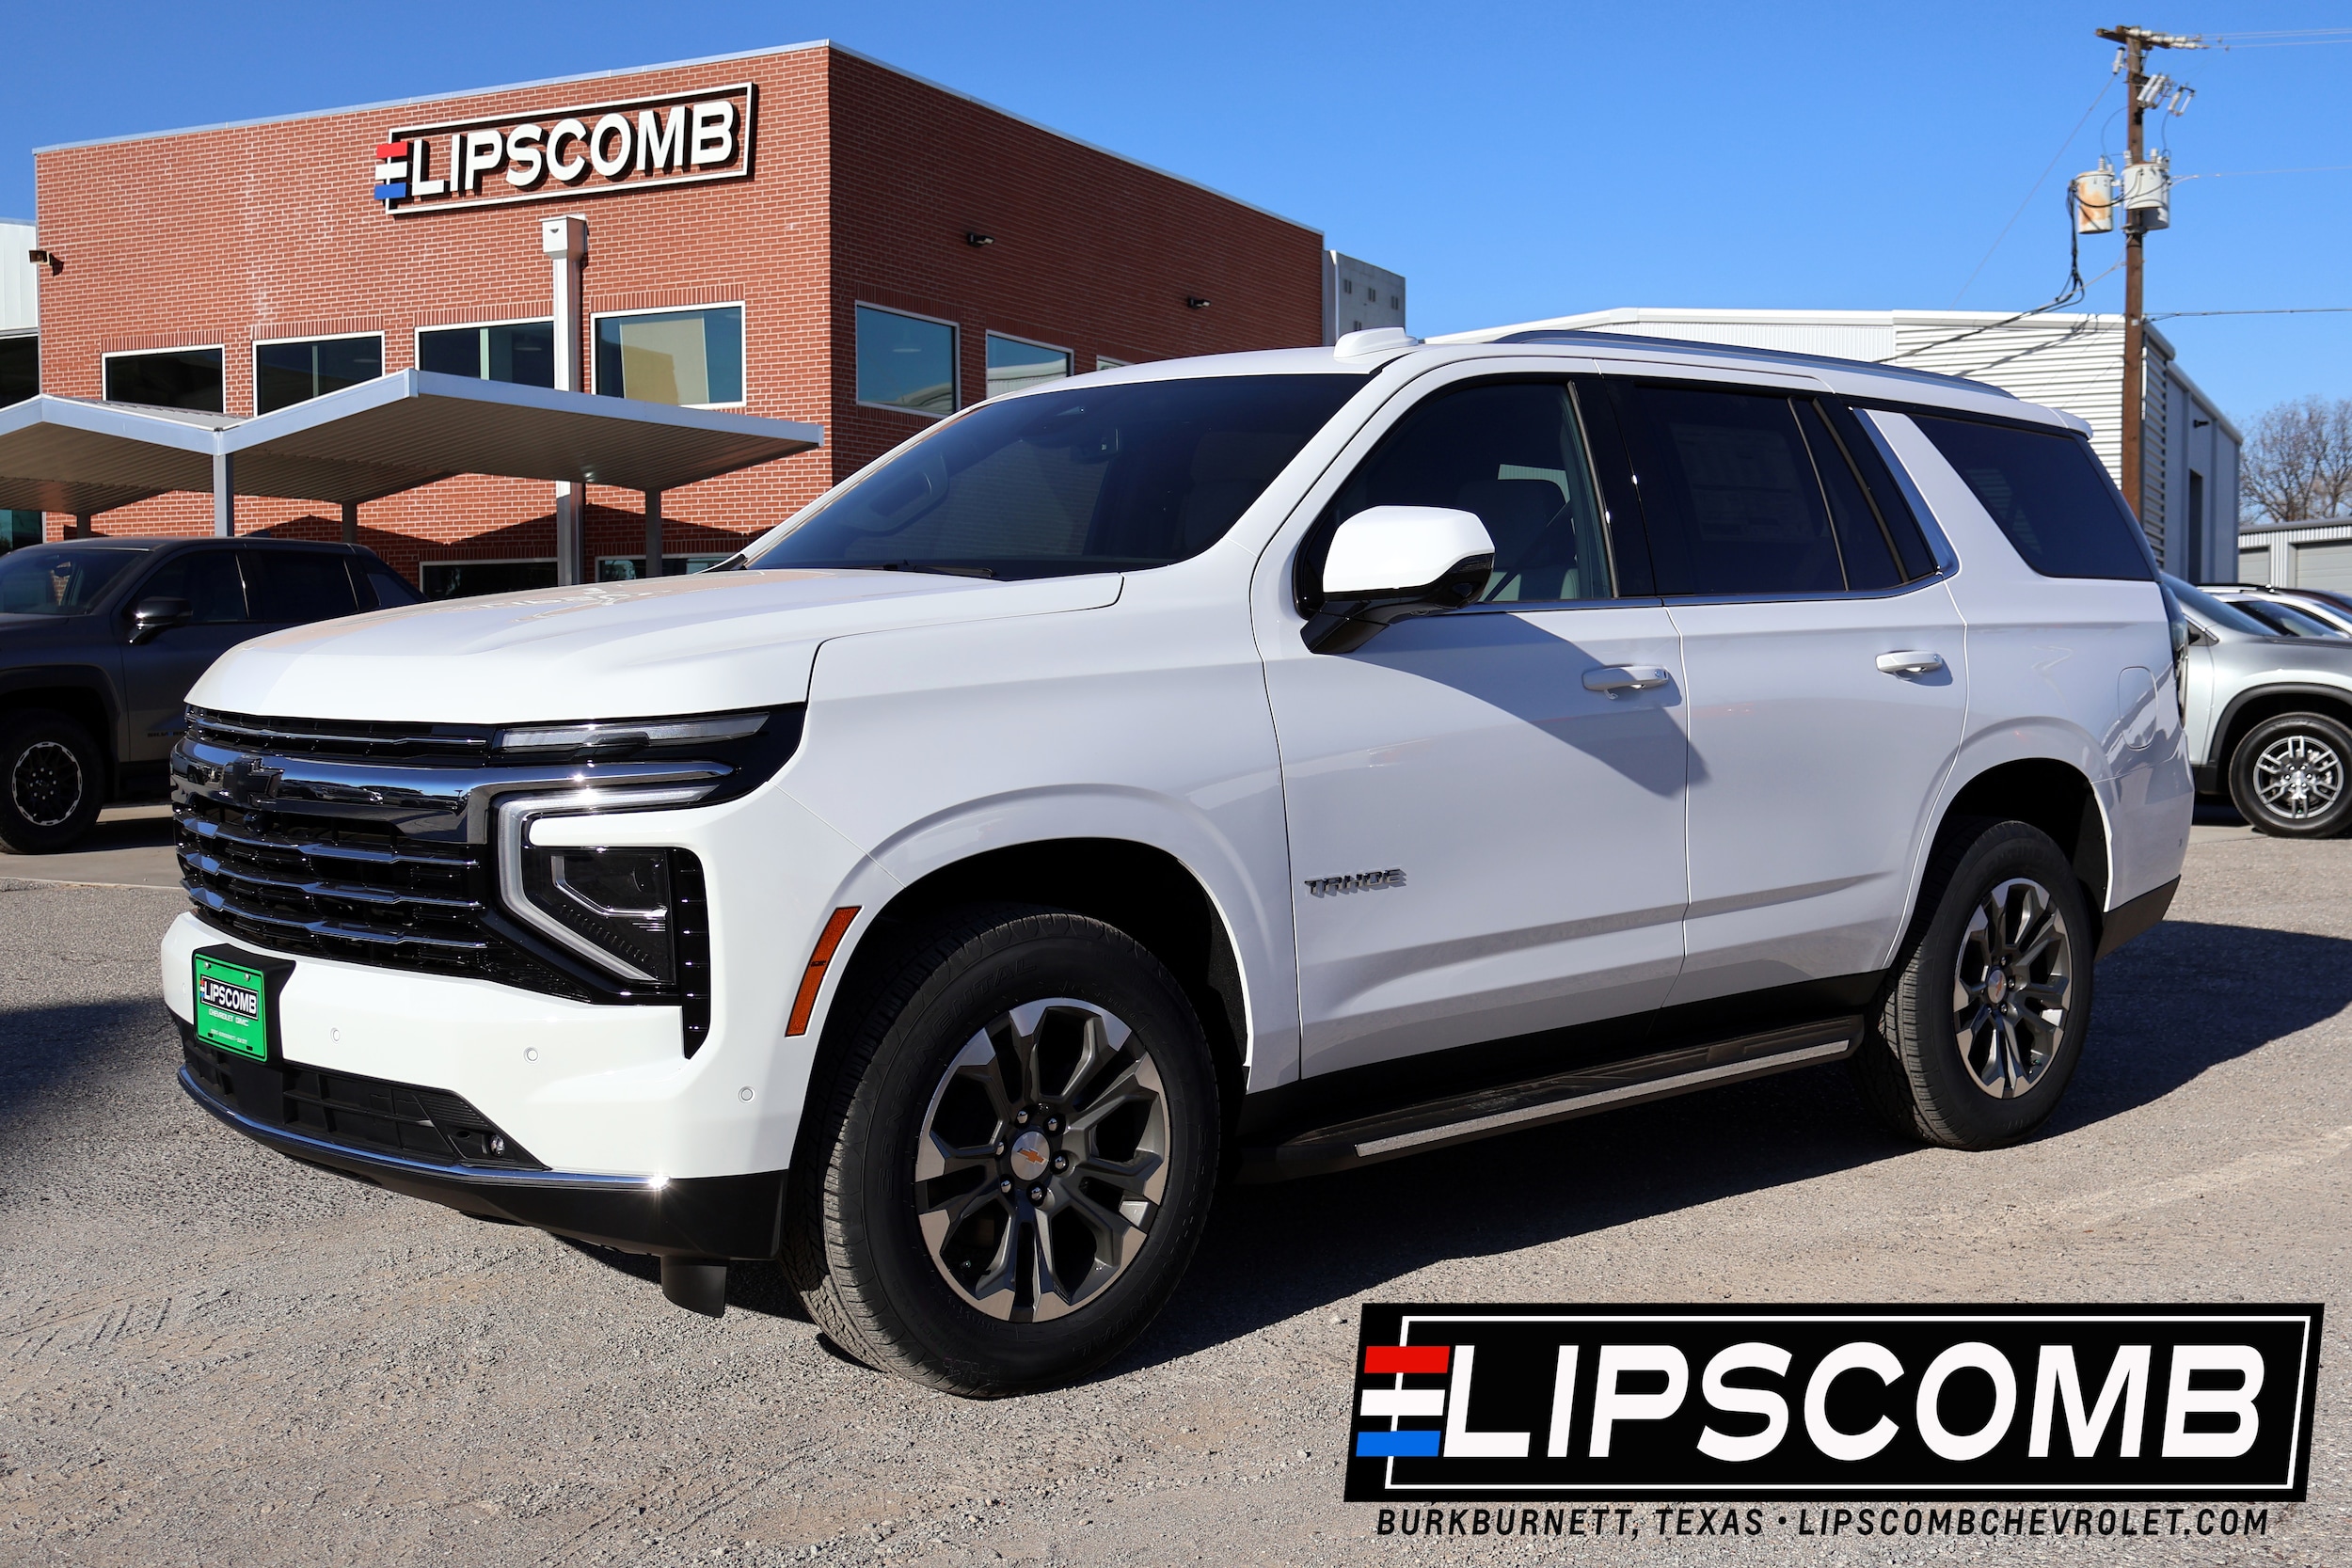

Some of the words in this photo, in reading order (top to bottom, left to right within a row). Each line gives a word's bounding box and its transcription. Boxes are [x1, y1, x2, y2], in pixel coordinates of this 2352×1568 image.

[411, 101, 735, 197] LIPSCOMB
[1304, 868, 1403, 894] TAHOE
[204, 980, 257, 1014] LIPSCOMB
[209, 1008, 233, 1022] CHEVROLET
[235, 1017, 249, 1027] GMC
